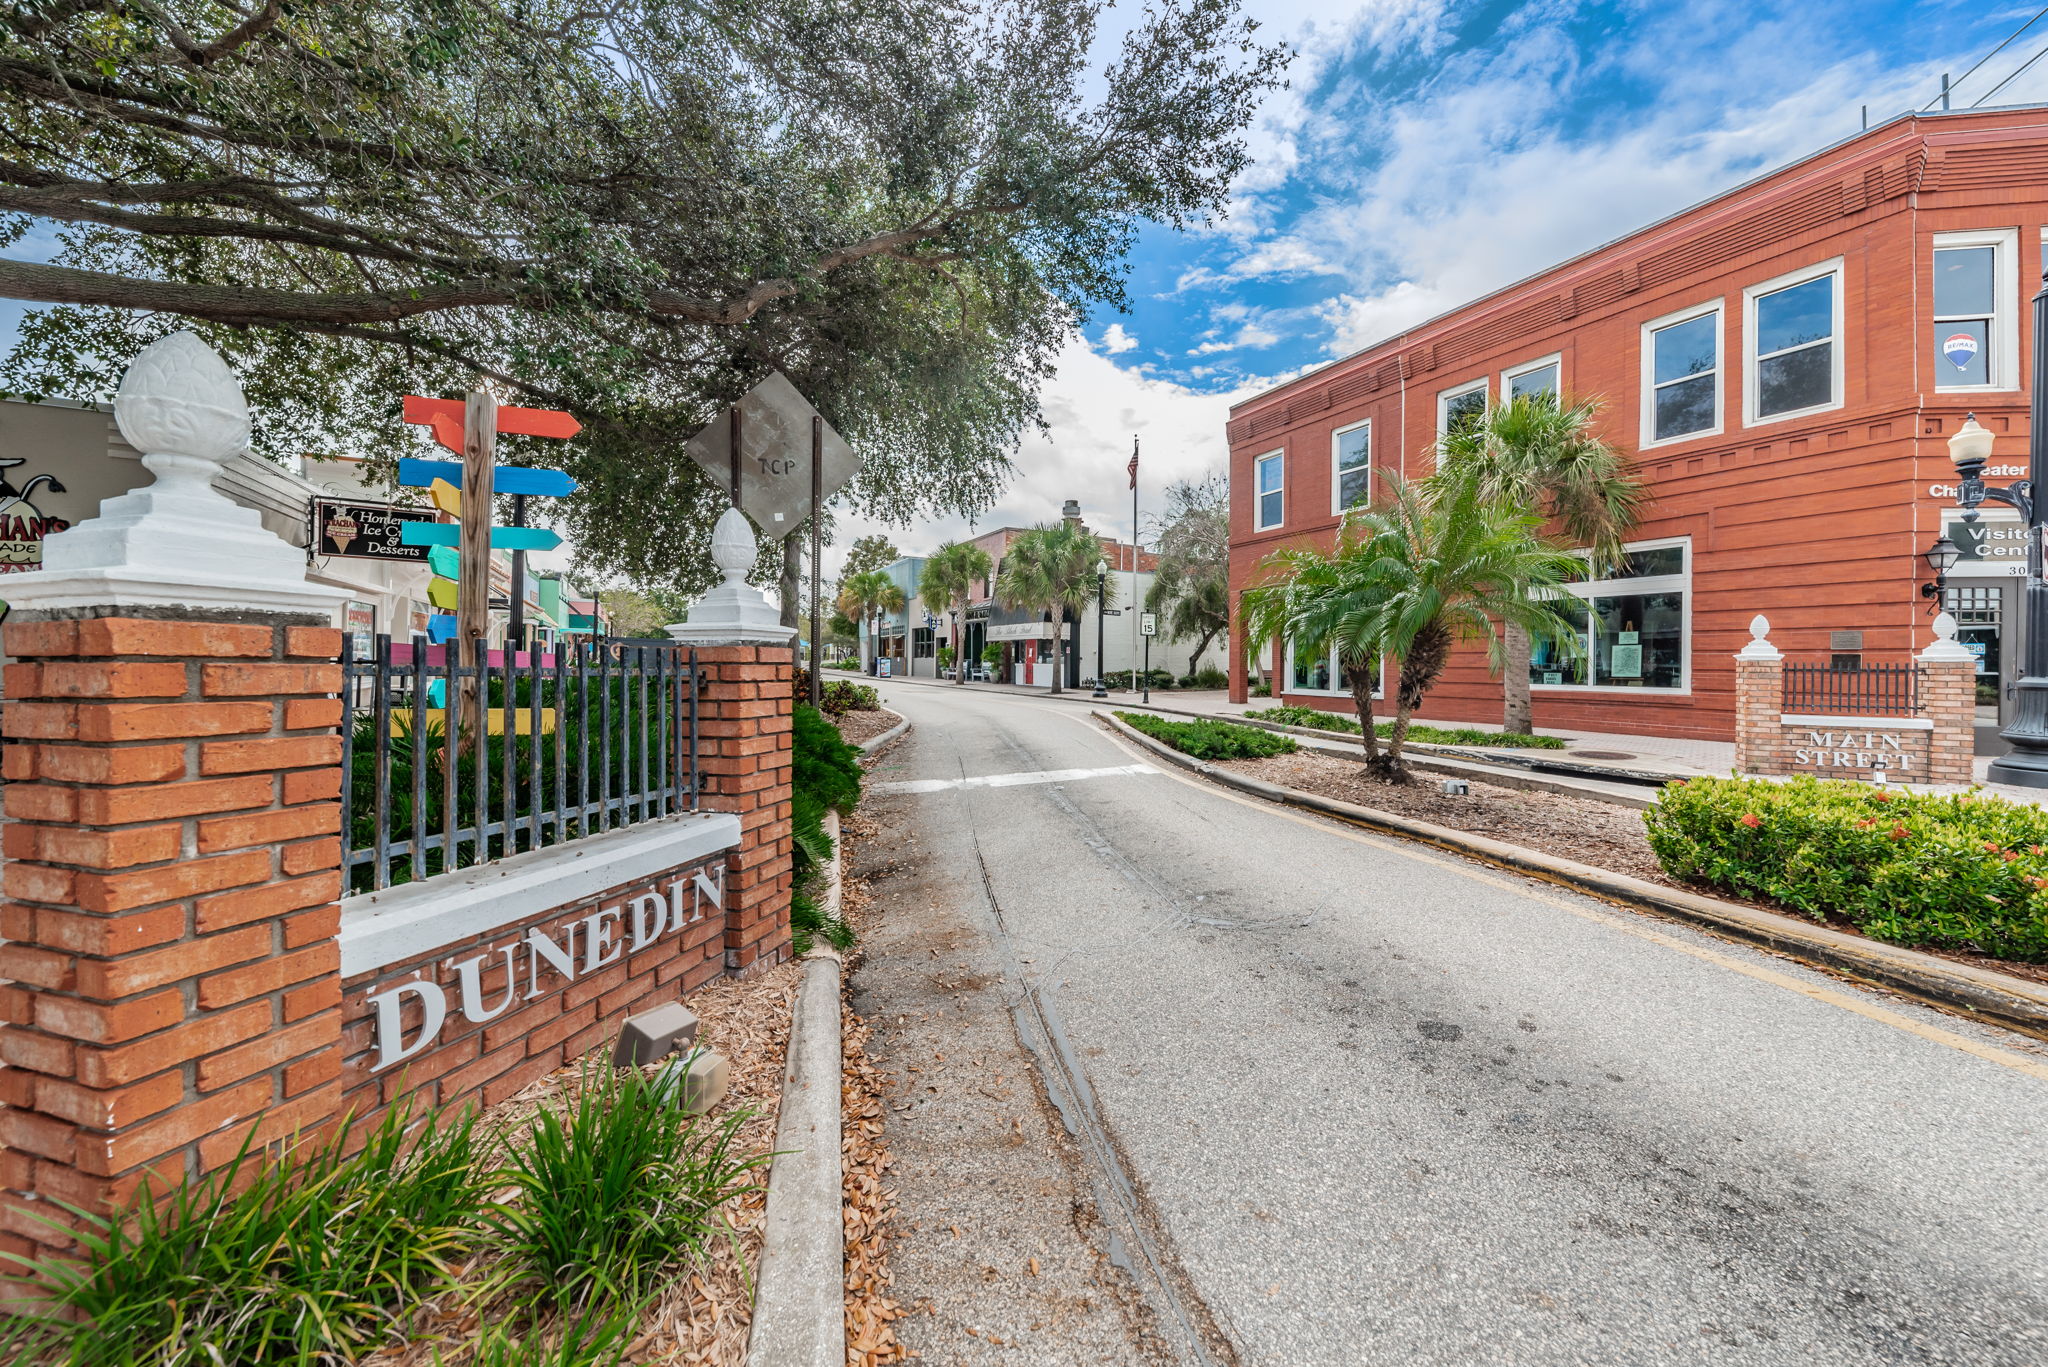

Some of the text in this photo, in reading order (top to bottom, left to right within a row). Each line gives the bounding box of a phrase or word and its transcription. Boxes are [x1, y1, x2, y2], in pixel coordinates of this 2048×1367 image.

[758, 458, 795, 474] TCP
[1980, 464, 2028, 476] eater
[363, 524, 382, 536] Ice
[1968, 528, 2029, 540] Visit
[387, 537, 399, 546] &
[0, 543, 37, 553] ADE
[367, 542, 420, 556] Desserts
[1974, 544, 2028, 556] Cent
[2009, 567, 2026, 576] 30
[1144, 624, 1153, 632] 15
[1808, 731, 1901, 750] MAIN
[1795, 749, 1914, 770] STREET
[368, 865, 727, 1073] DUNEDIN
